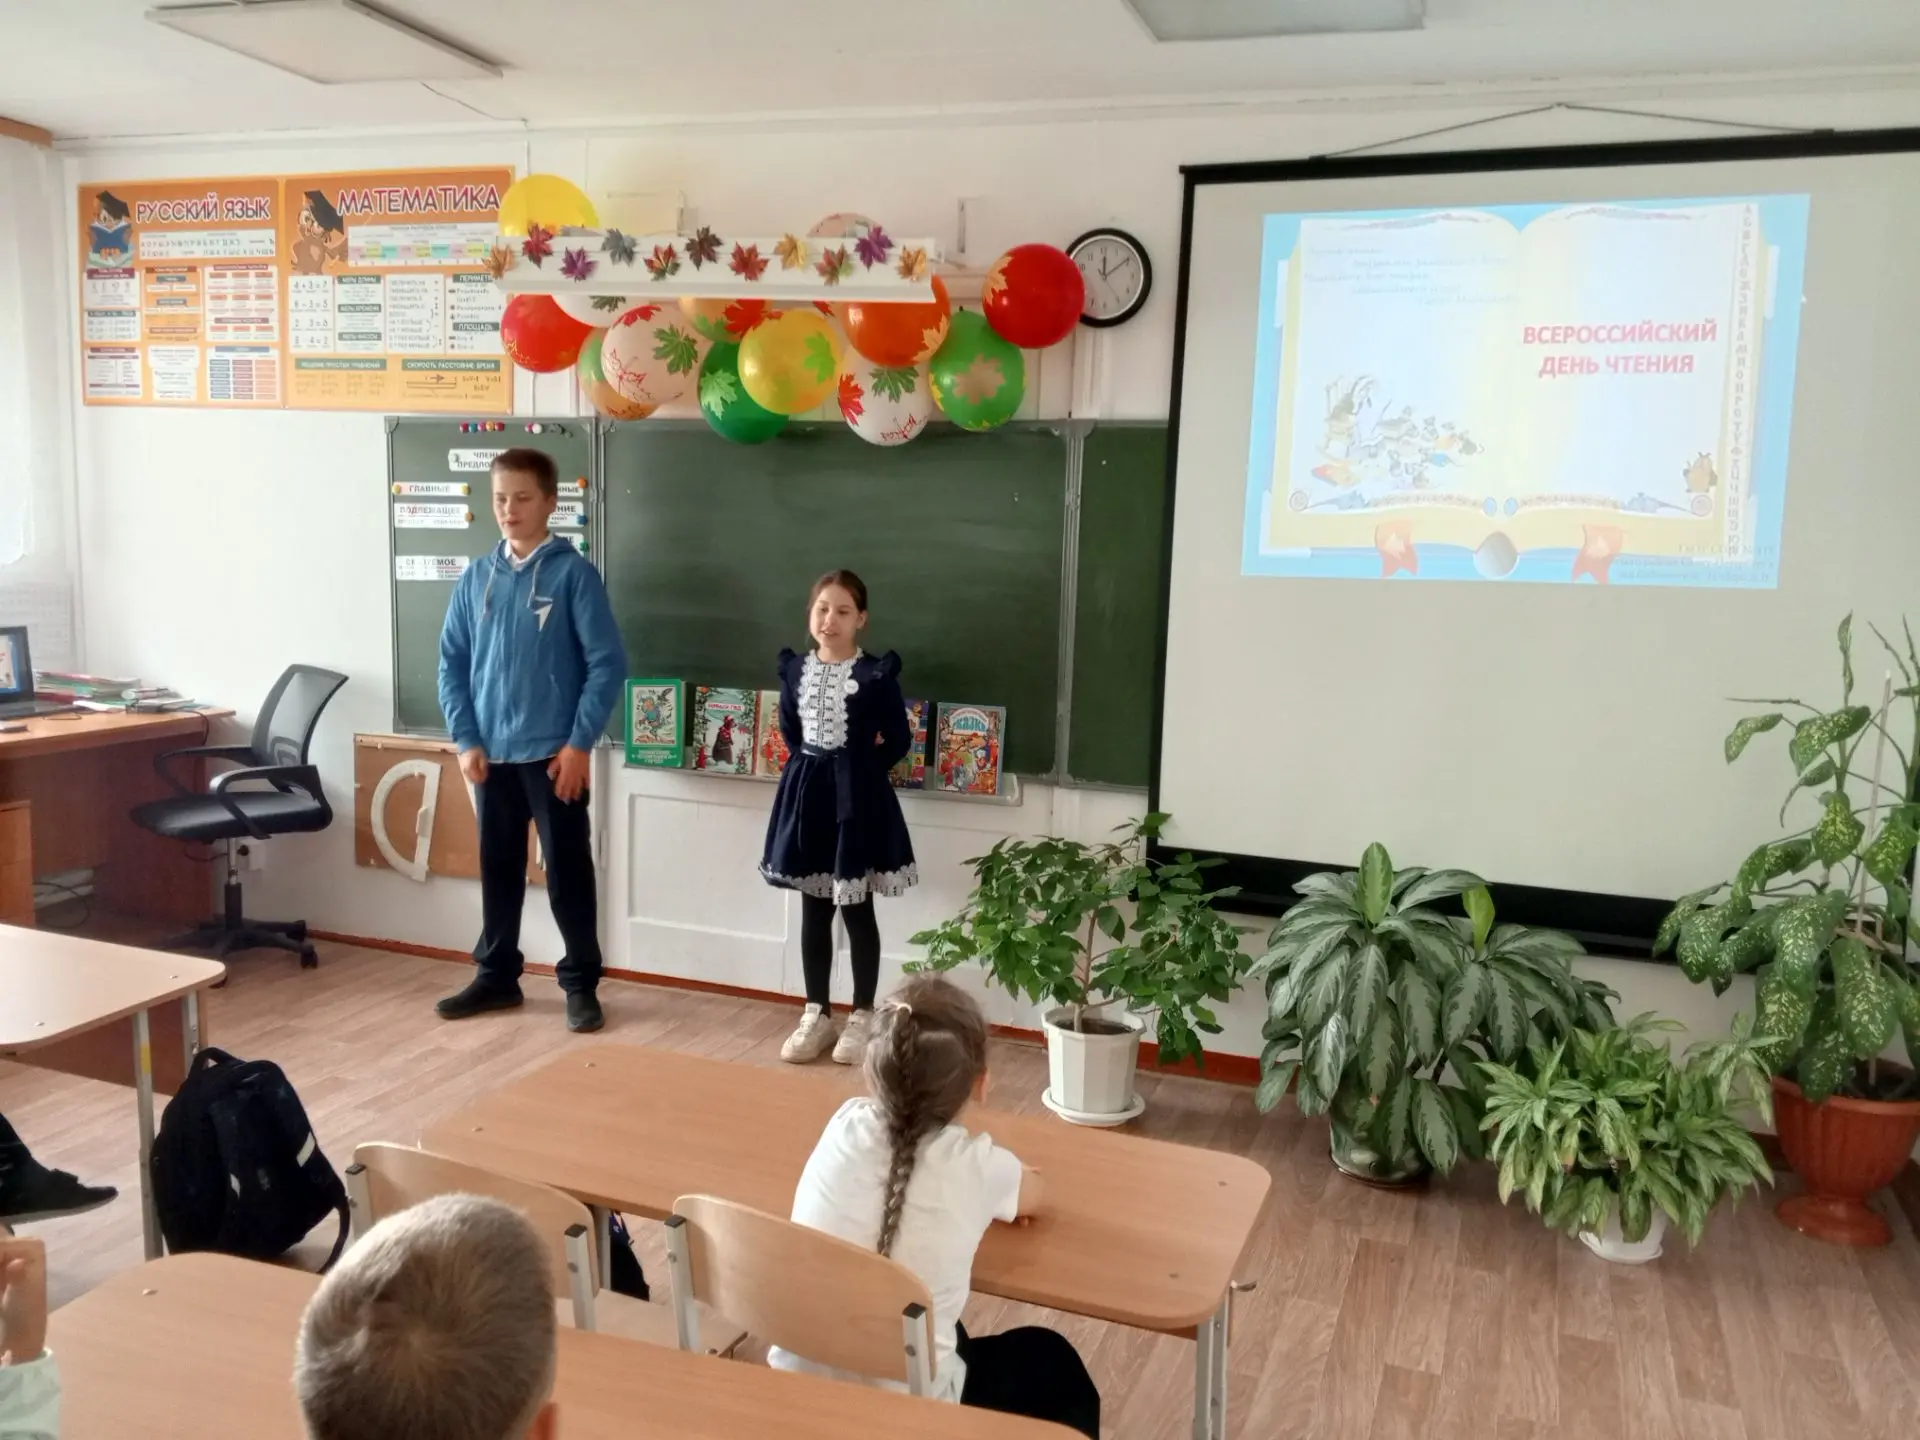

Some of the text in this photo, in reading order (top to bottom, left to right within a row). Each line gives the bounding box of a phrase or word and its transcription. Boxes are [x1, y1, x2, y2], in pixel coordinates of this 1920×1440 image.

[136, 192, 270, 224] РУССКИЙ ЯЗЫК
[337, 184, 501, 216] МАТЕМАТИКА
[459, 323, 493, 331] ПЛОЩАДЬ
[1523, 318, 1717, 344] ВСЕРОССИЙСКИЙ
[1538, 354, 1694, 379] ДЕНЬ ЧТЕНИЯ
[457, 460, 491, 469] ПРЕДЛО
[409, 485, 450, 493] ГЛАВНЫЕ
[399, 506, 461, 516] ПОДЛЕЖАЩЕЕ
